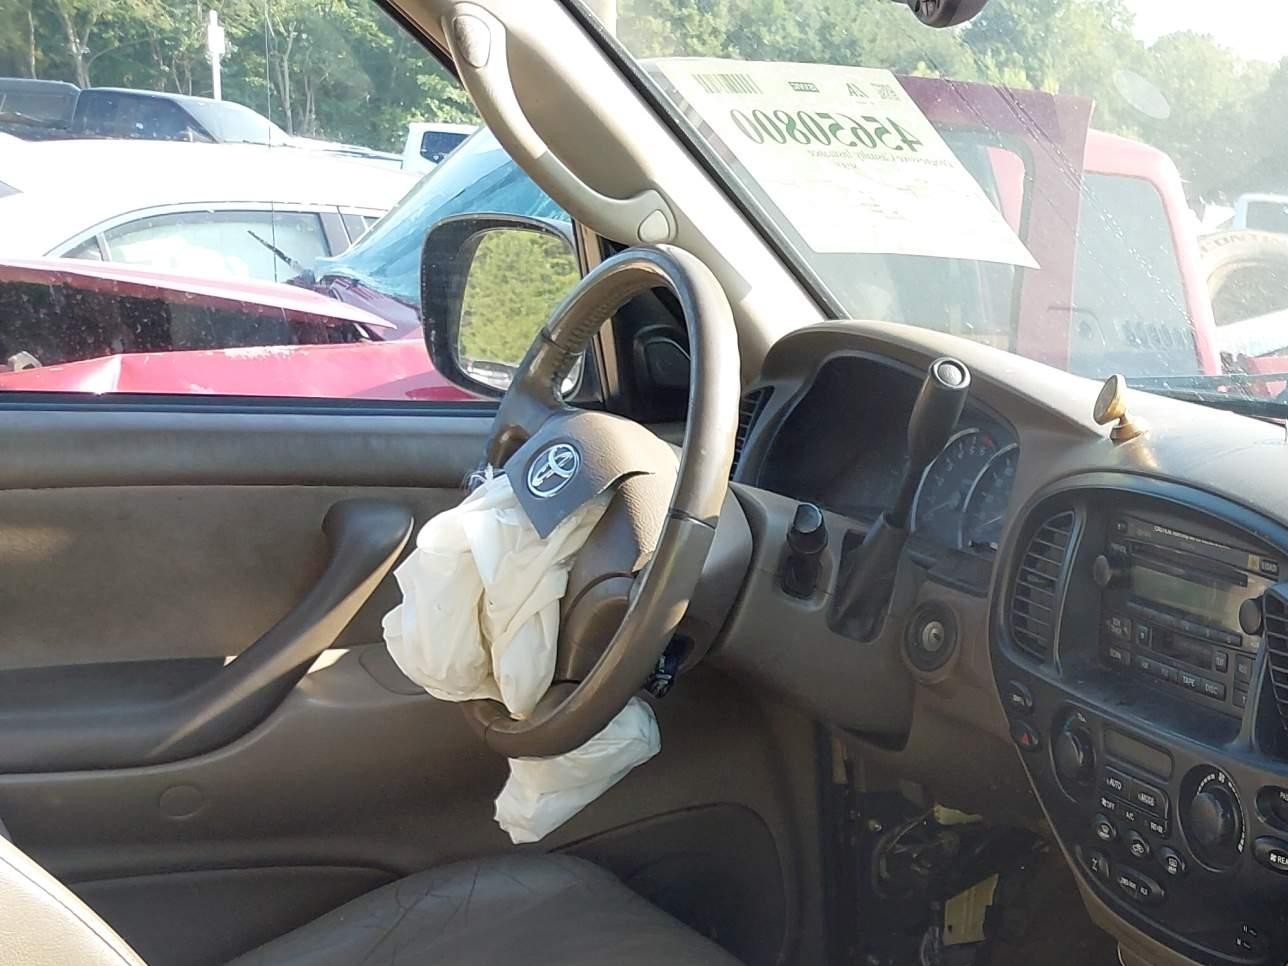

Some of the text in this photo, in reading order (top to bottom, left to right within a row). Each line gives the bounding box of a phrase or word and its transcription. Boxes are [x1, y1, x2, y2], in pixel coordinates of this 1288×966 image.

[1183, 675, 1196, 688] TAPE
[1205, 683, 1219, 695] DISC
[1109, 778, 1122, 791] AUTO
